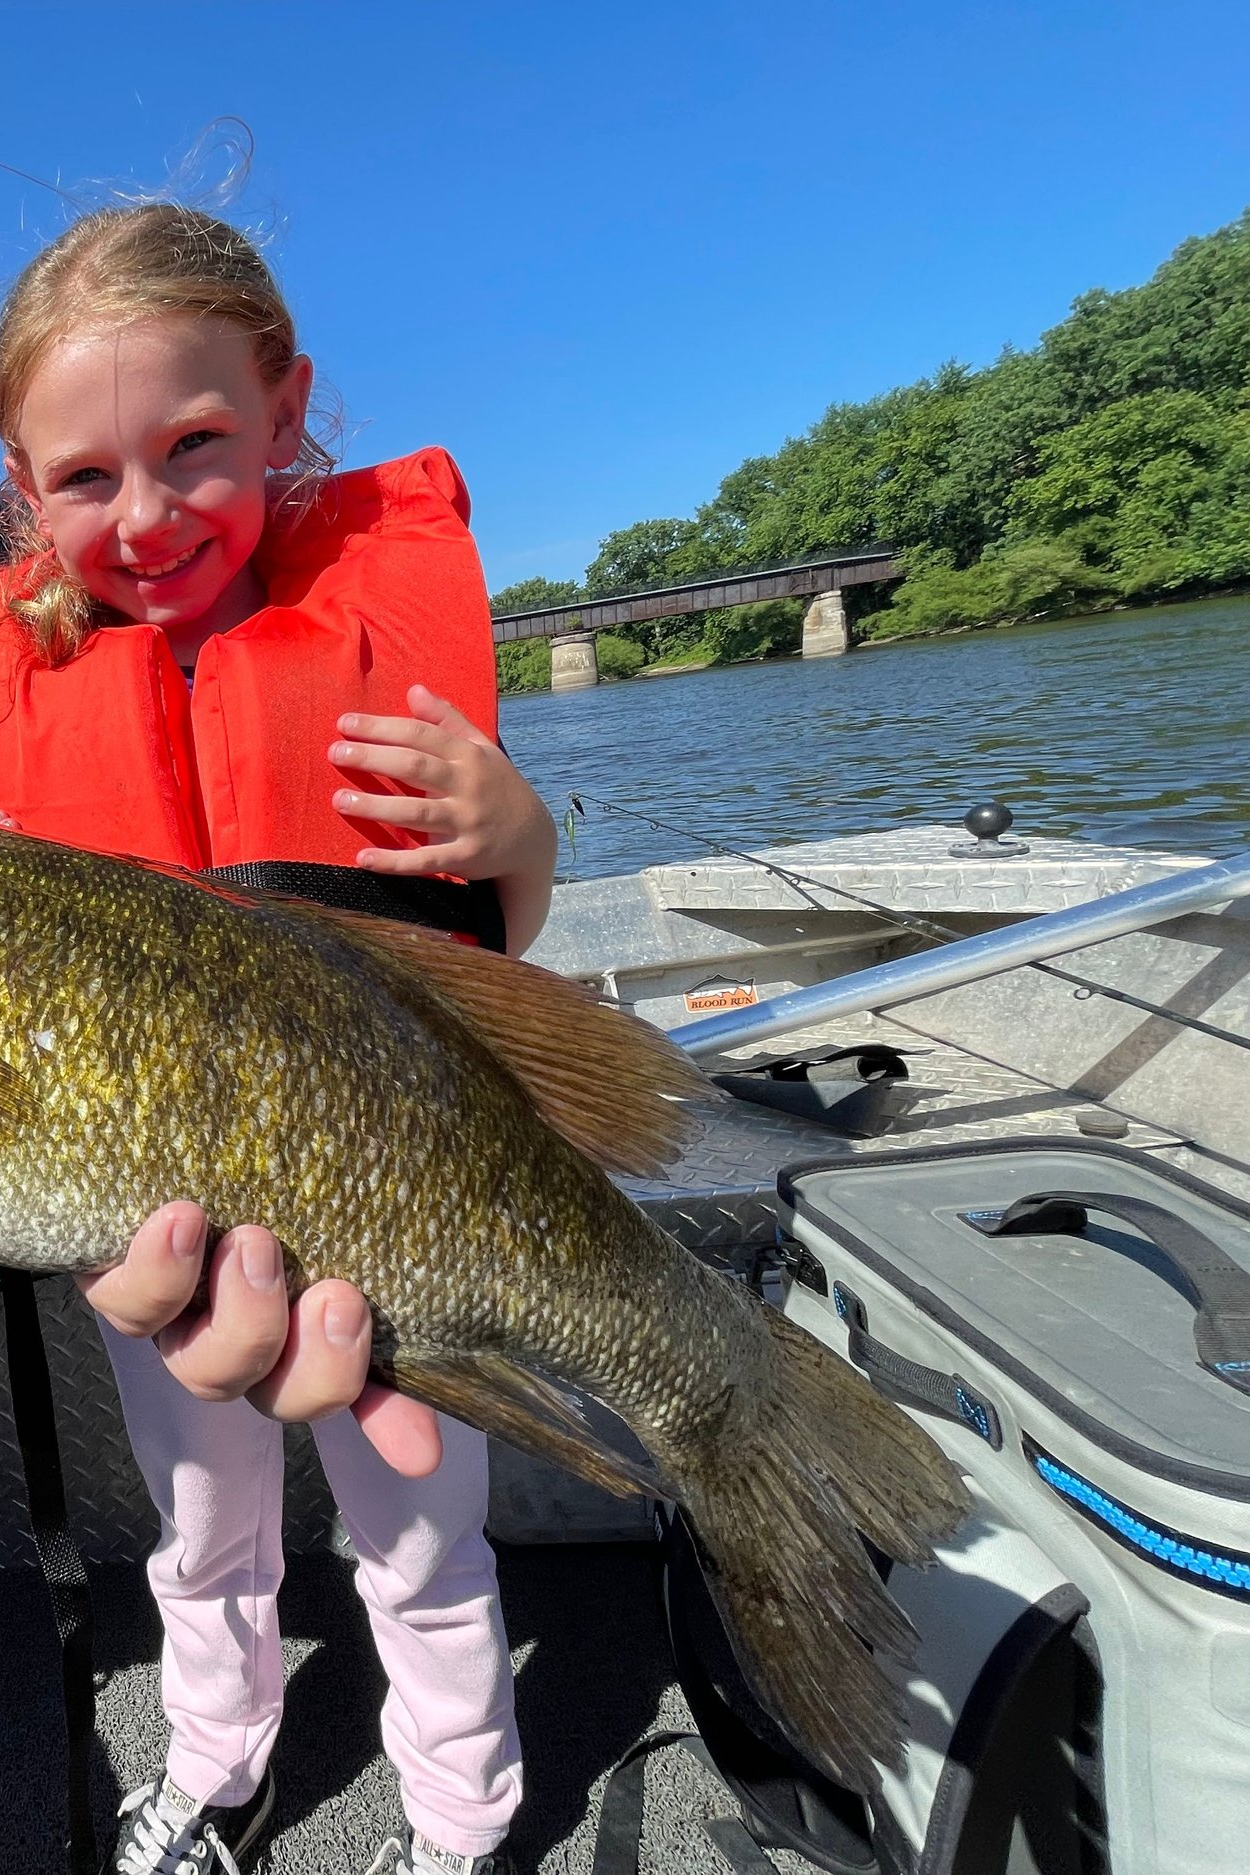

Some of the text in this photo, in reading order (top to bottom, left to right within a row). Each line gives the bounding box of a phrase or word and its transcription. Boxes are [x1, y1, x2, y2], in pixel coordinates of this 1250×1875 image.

[691, 996, 753, 1009] BLOOD RUN
[176, 1795, 193, 1814] STAR
[444, 1851, 463, 1873] STAR
